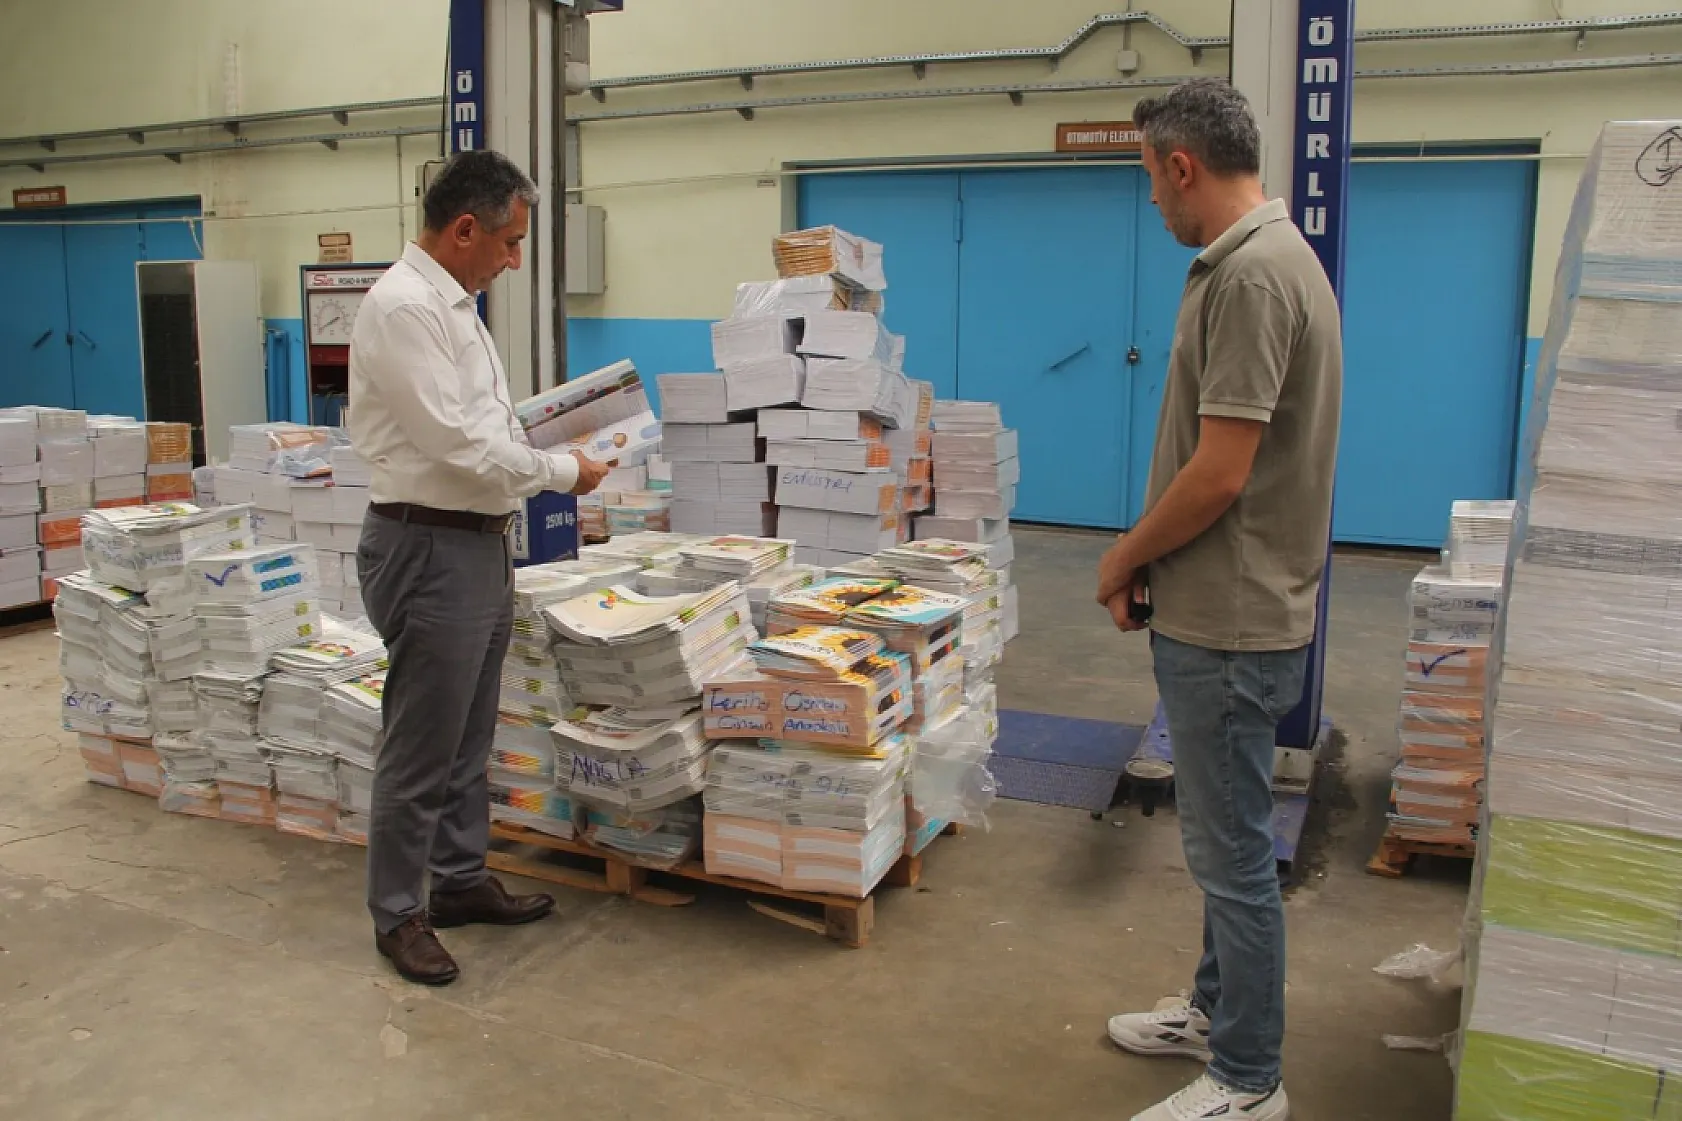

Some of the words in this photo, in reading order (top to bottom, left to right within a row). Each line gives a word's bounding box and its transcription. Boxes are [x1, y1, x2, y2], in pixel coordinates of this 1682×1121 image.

[455, 69, 477, 152] ÖMÜ
[1066, 130, 1108, 144] OTOMOTİV
[1109, 130, 1144, 143] ELEKTR
[545, 512, 563, 530] 2500
